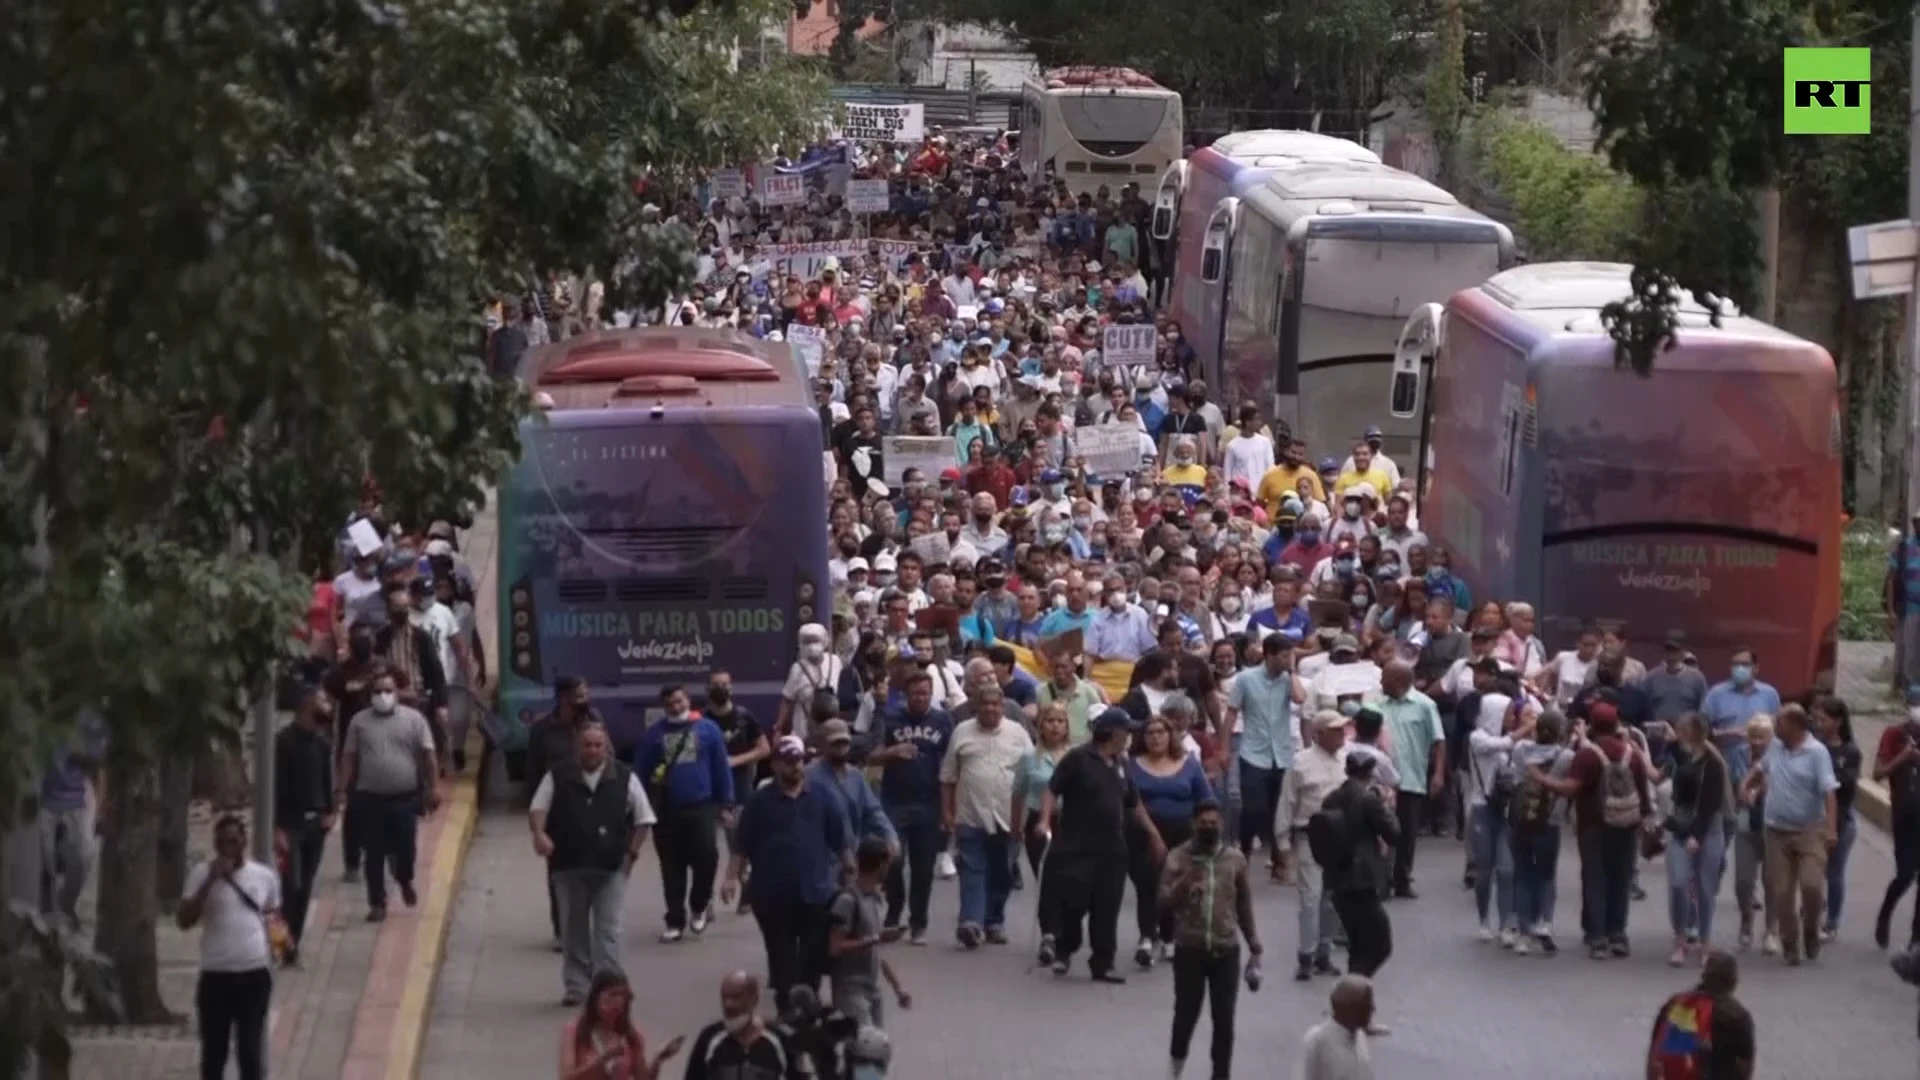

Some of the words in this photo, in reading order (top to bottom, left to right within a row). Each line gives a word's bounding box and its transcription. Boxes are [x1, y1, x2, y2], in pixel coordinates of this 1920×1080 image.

[883, 118, 904, 130] SUS
[1655, 544, 1708, 567] PARA
[544, 606, 631, 638] MÚSICA
[639, 609, 701, 636] PARA
[708, 607, 784, 635] TODOS
[893, 725, 942, 744] COACH
